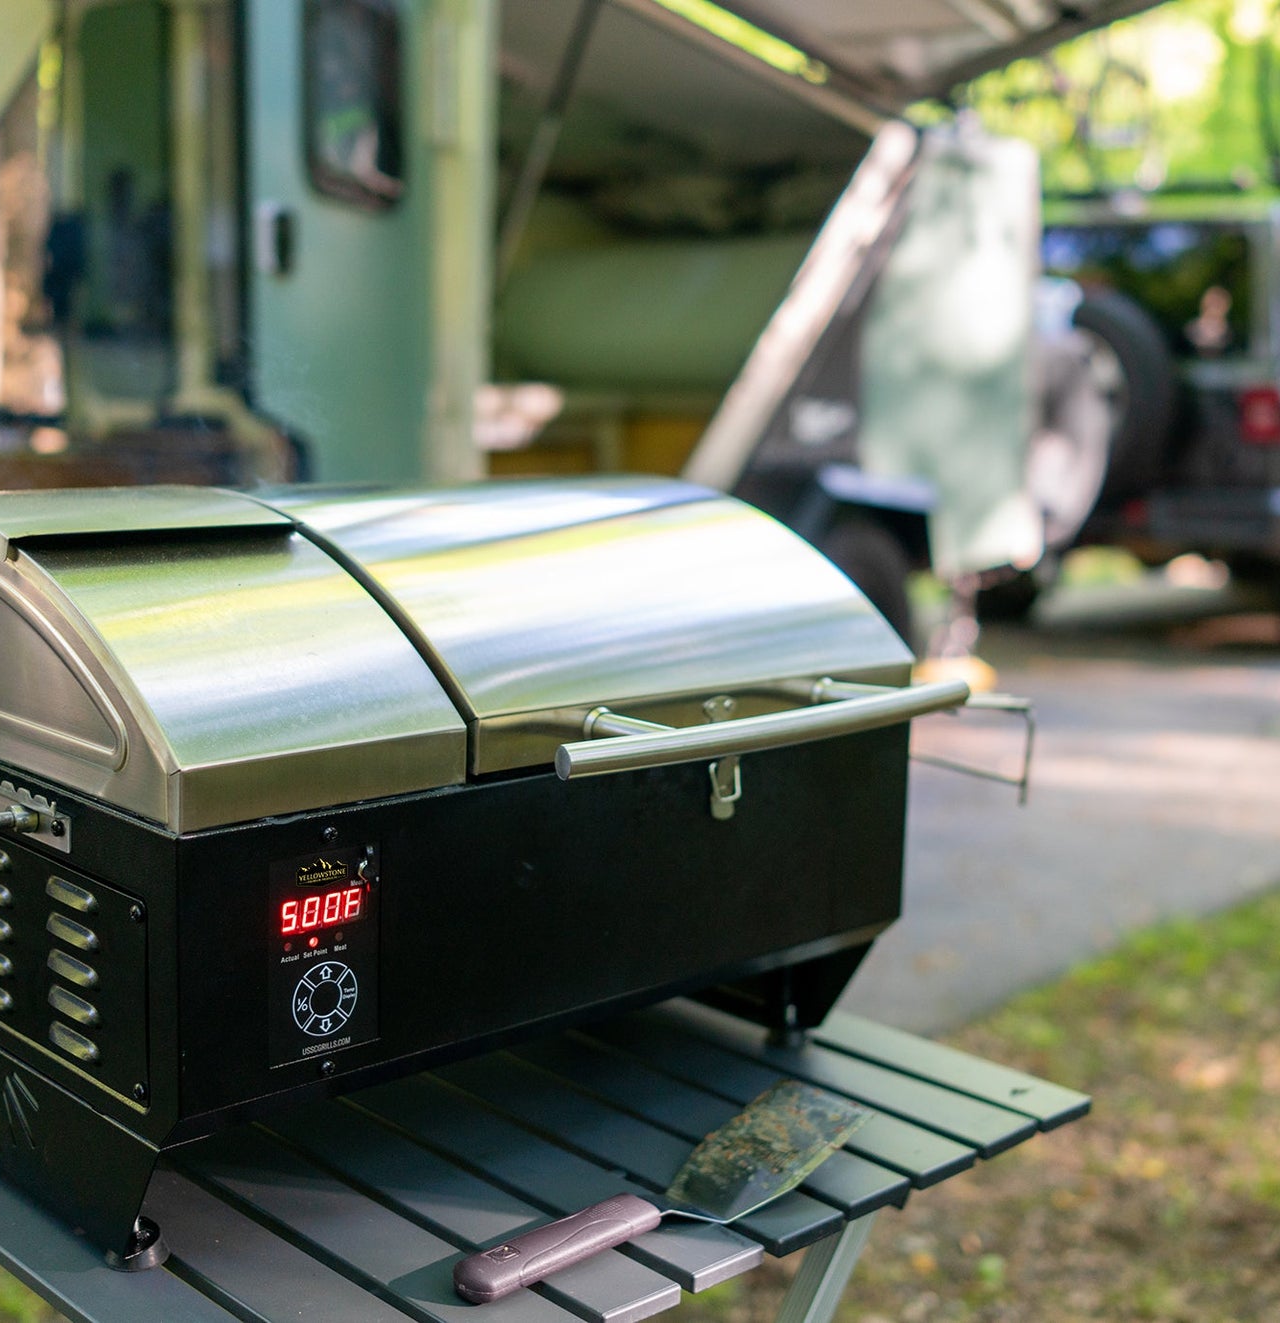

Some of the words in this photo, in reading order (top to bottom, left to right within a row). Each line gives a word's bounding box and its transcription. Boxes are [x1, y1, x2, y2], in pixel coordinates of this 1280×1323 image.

[298, 867, 347, 882] YELLOWSTONE
[303, 951, 313, 959] Set
[313, 948, 328, 957] Point
[334, 944, 347, 952] Meat
[280, 954, 300, 963] Actual
[302, 1036, 351, 1055] USSCGRILLS.COM
